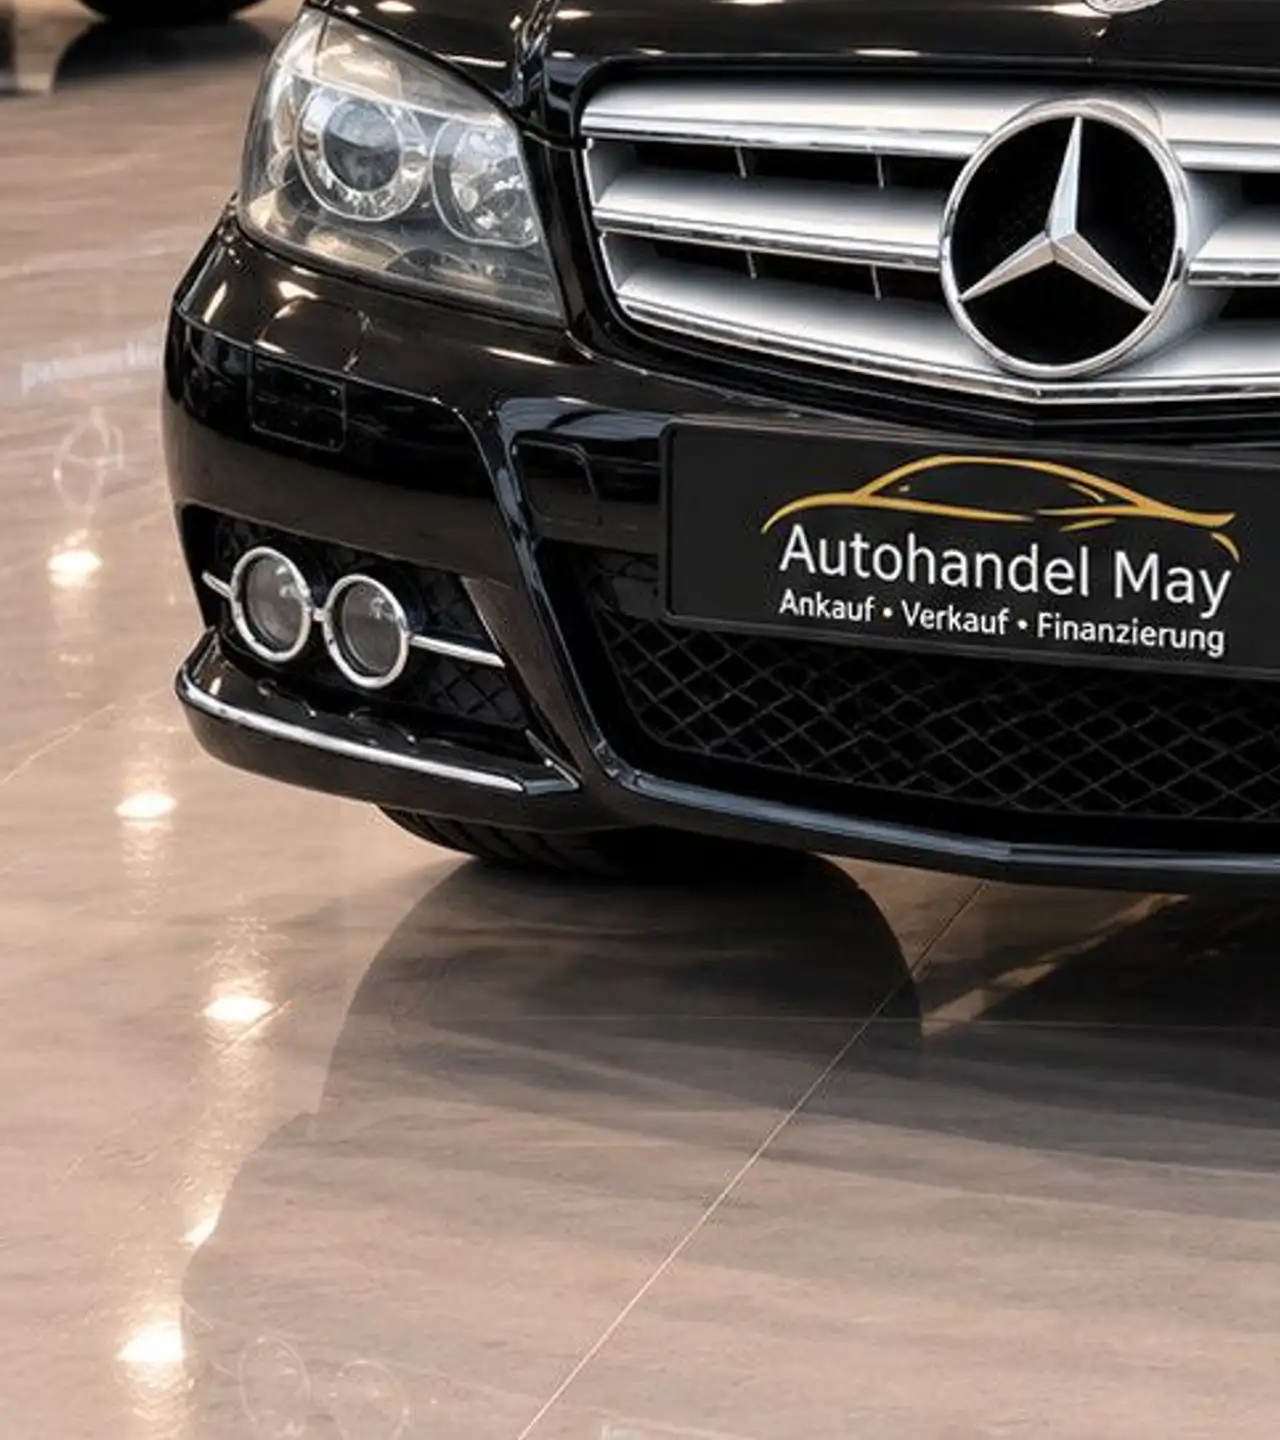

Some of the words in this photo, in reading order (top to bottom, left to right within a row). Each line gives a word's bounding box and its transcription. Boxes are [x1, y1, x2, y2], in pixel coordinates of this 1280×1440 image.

[778, 523, 1090, 597] Autohandel
[1114, 549, 1231, 621] May
[778, 589, 876, 623] Ankauf
[900, 599, 1010, 637] Verkauf
[1036, 611, 1226, 658] Finanzierung
